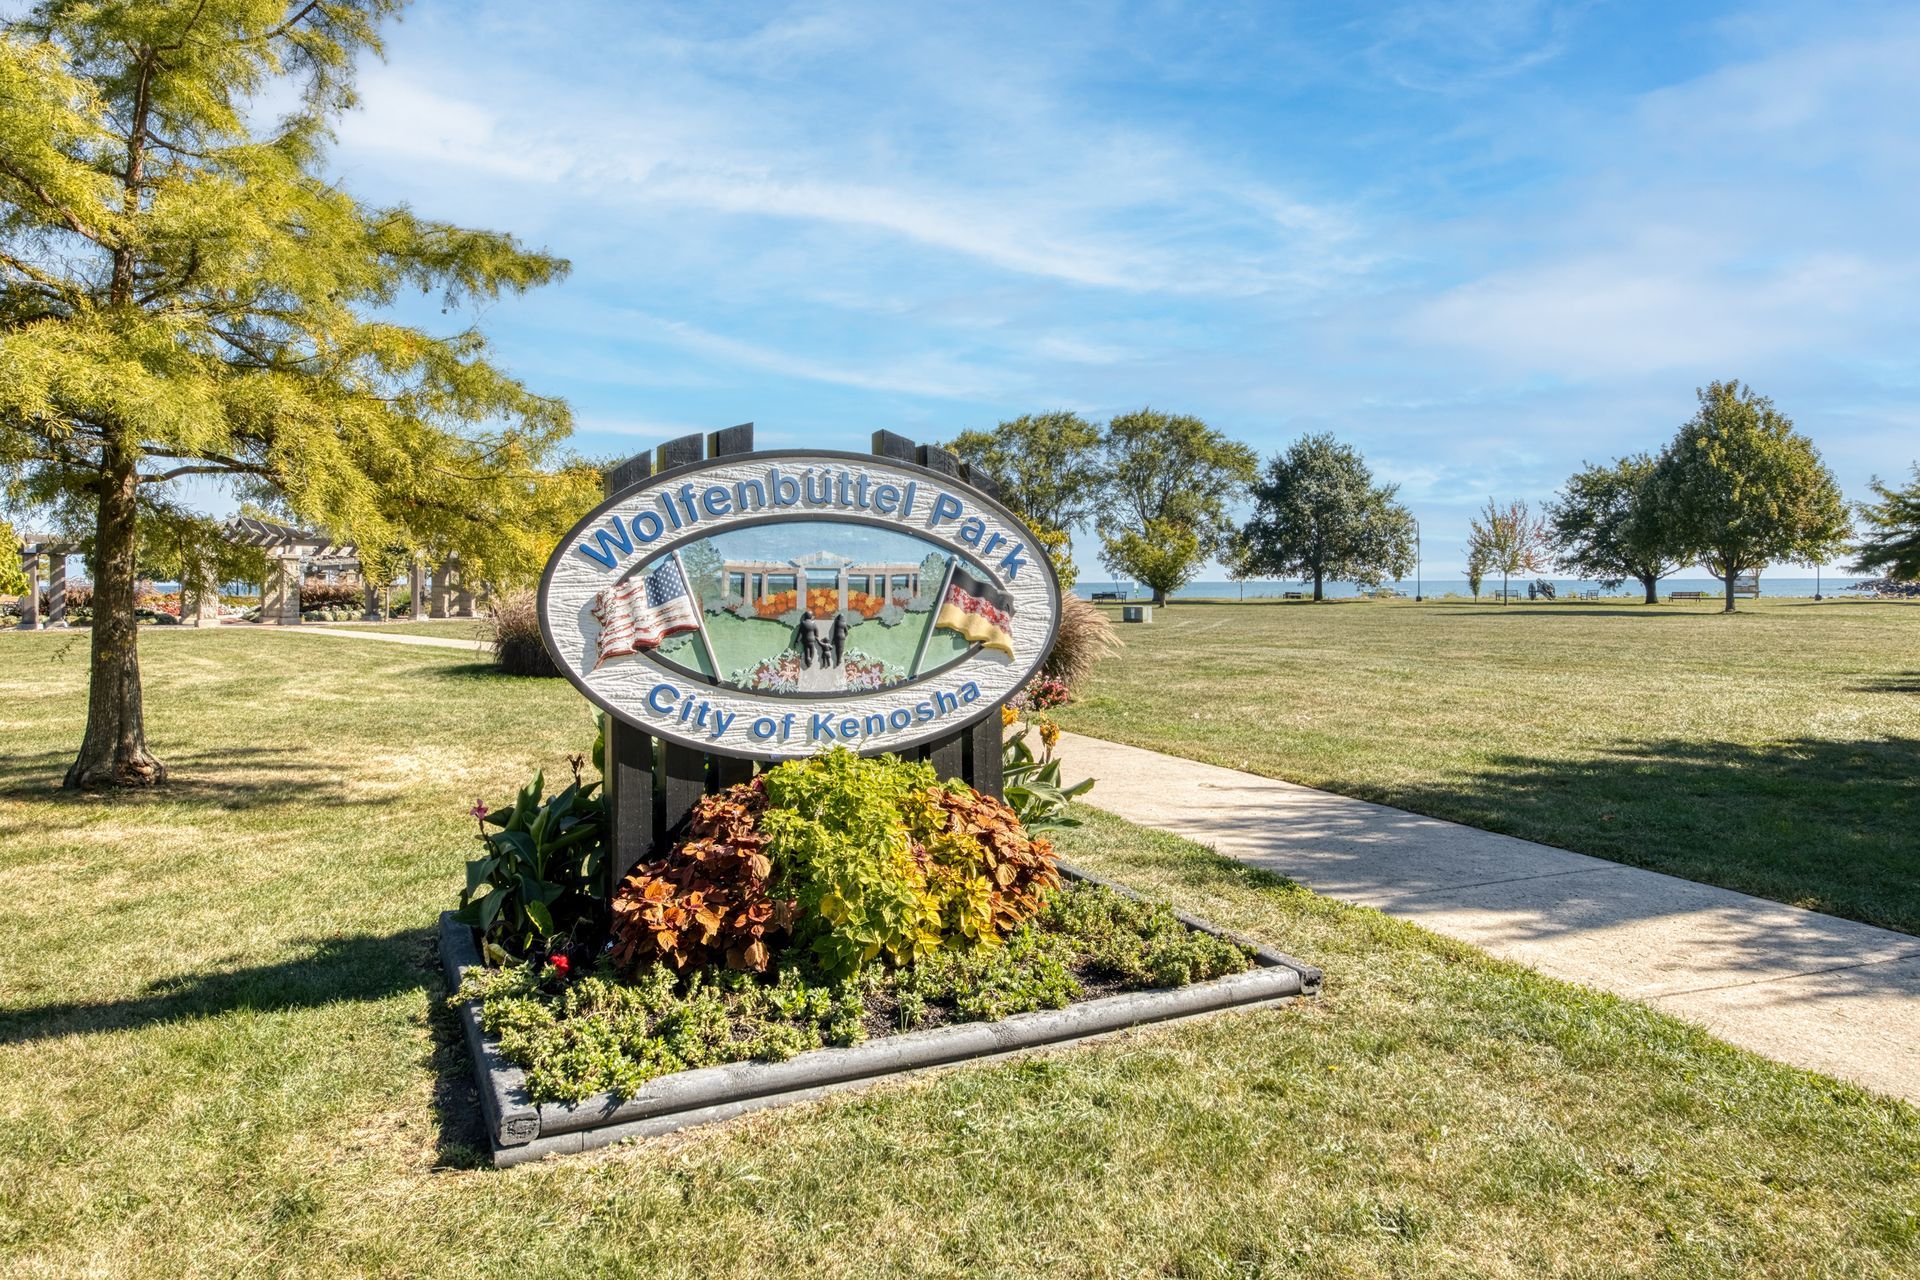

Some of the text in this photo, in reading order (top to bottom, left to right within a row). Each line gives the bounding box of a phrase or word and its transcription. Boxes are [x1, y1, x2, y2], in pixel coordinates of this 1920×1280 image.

[579, 468, 1027, 579] Wolfenbüttel Park
[648, 681, 982, 740] City of Kenosha
